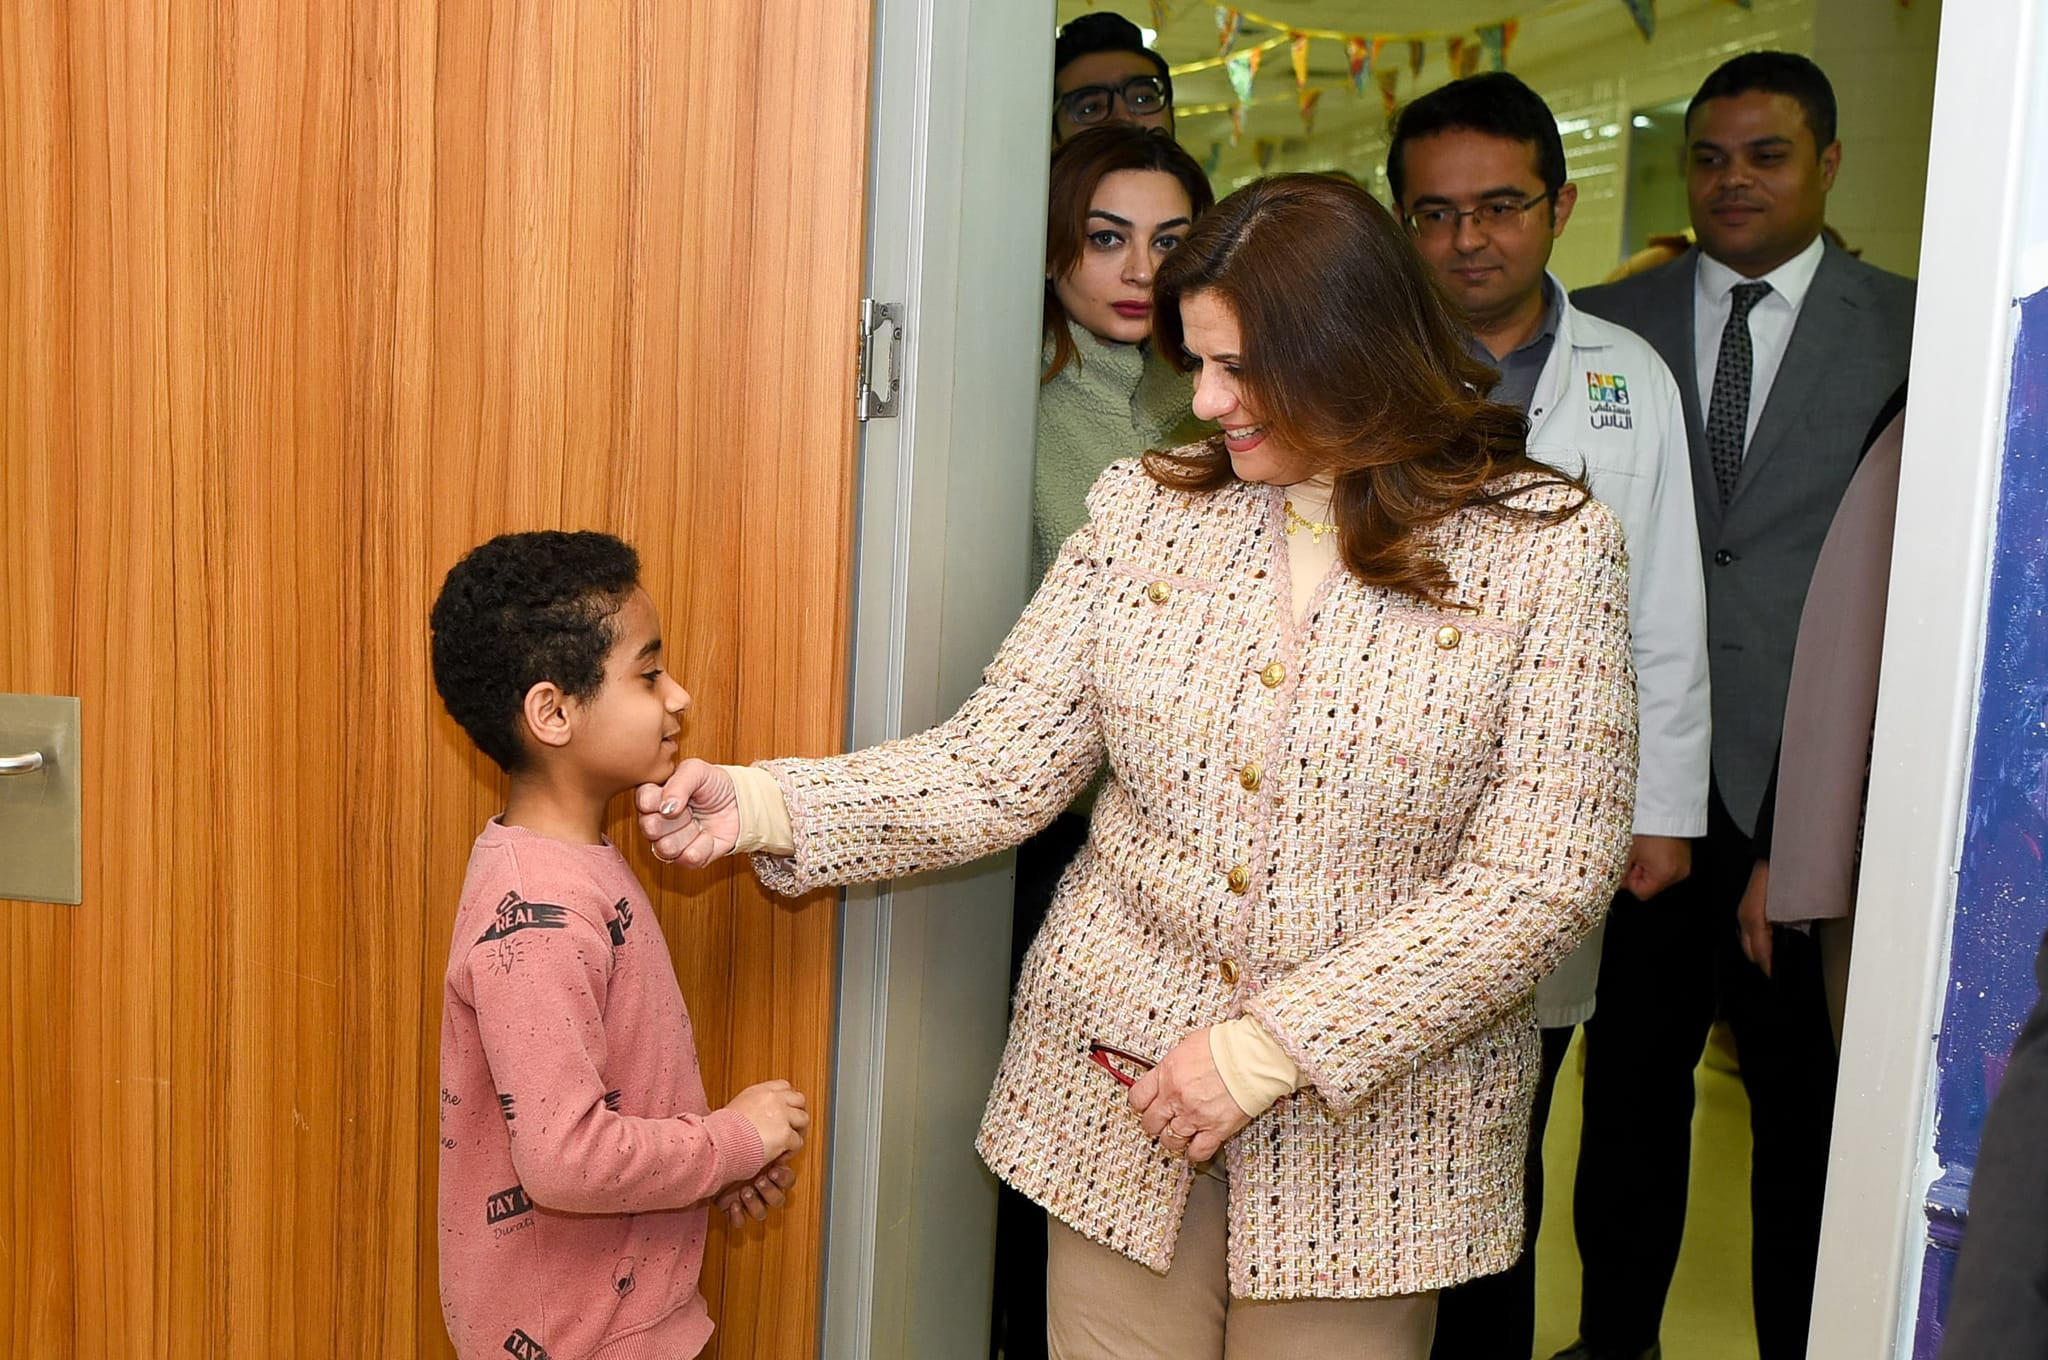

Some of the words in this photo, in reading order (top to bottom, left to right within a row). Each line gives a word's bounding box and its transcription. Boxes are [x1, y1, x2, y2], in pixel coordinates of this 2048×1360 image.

[1589, 387, 1628, 404] NAS
[1590, 413, 1633, 430] الناس
[495, 908, 540, 933] REAL
